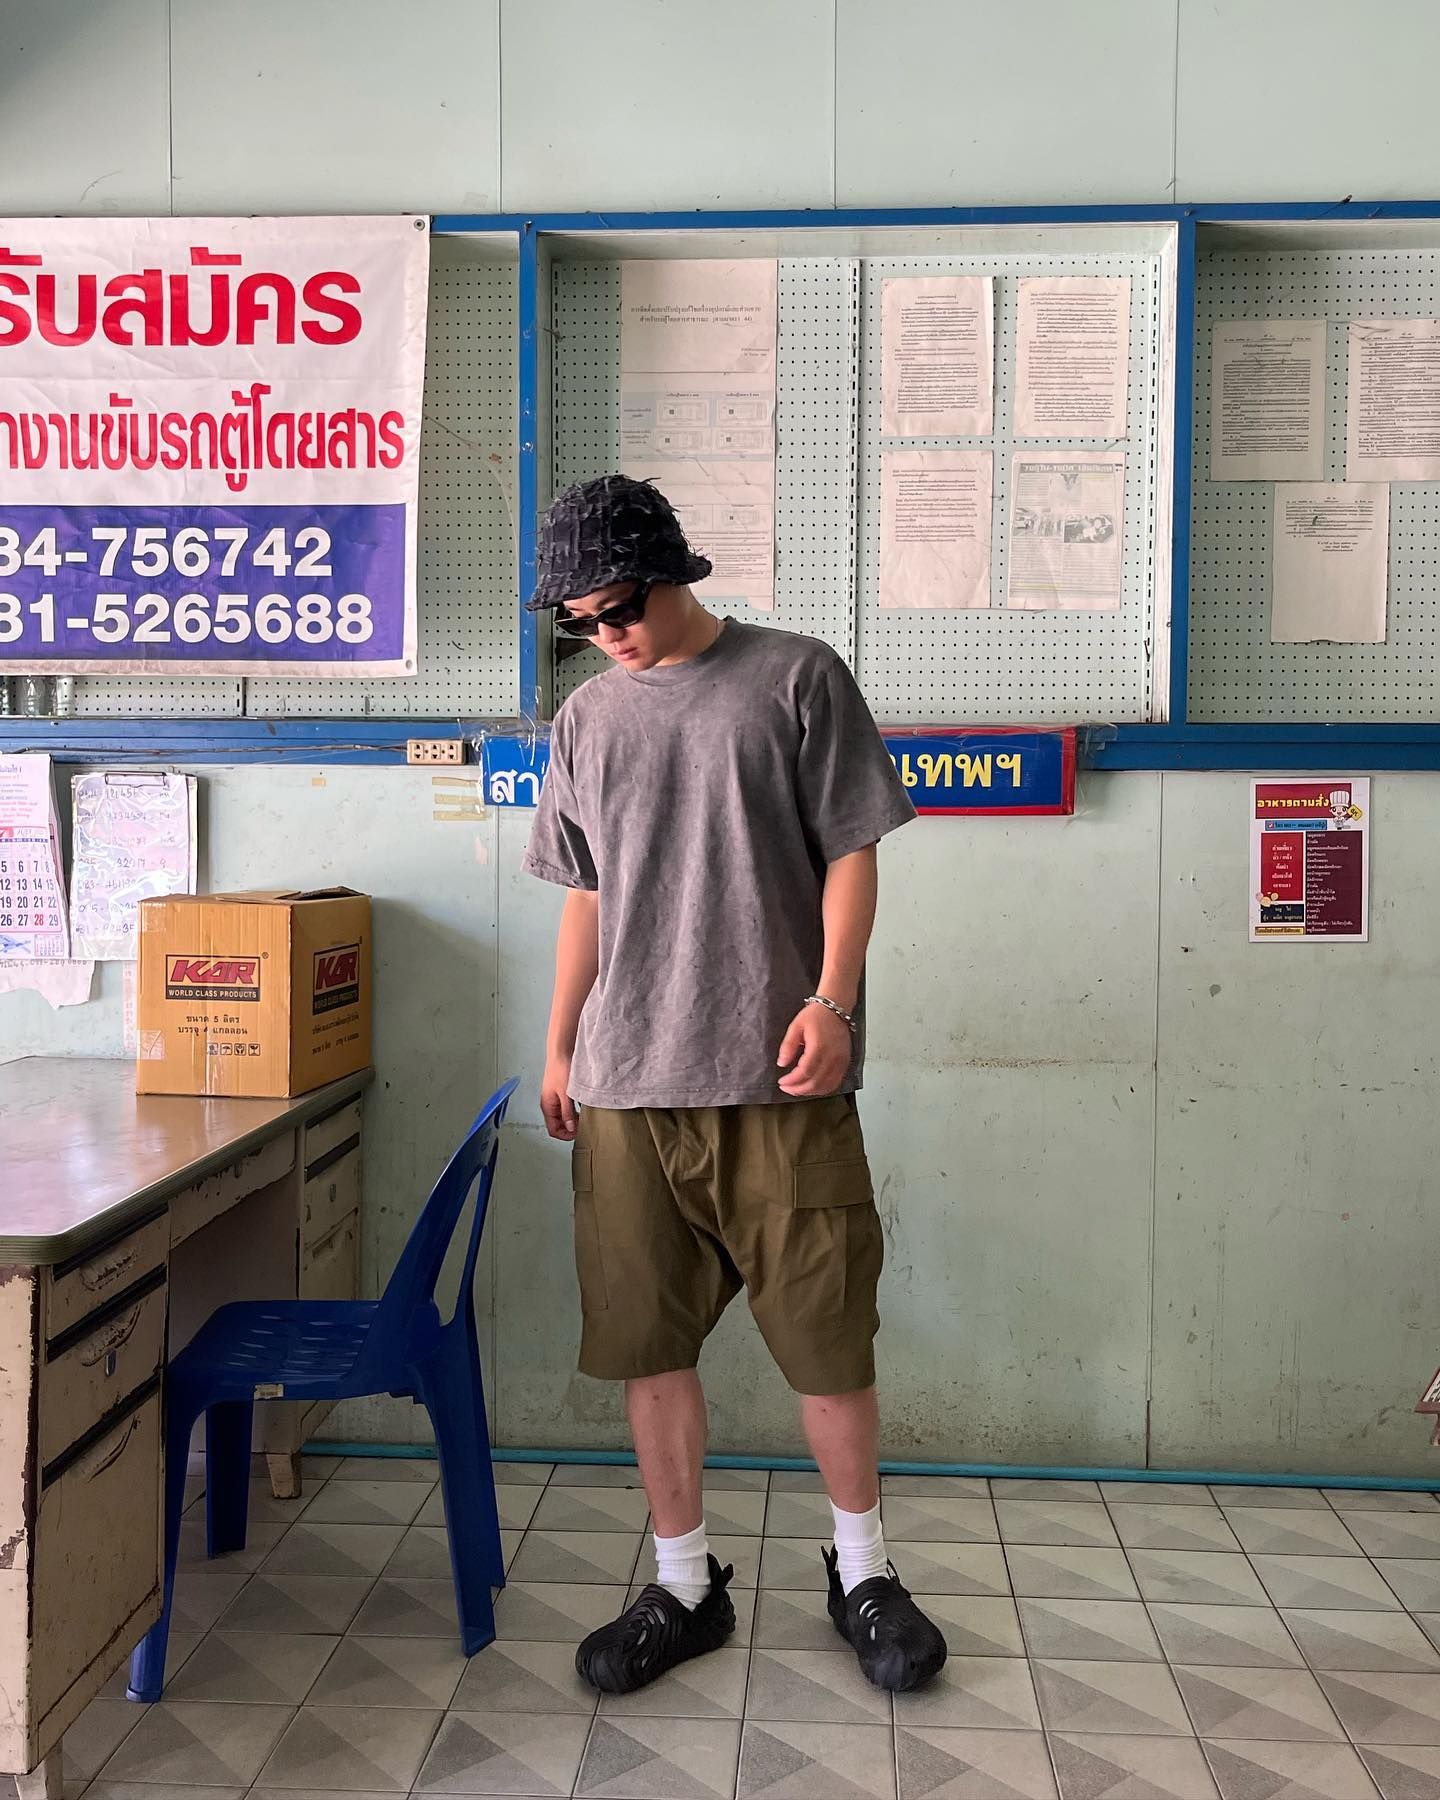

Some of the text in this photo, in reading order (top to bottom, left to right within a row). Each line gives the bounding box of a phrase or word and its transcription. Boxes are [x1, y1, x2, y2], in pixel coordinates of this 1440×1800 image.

[0, 593, 374, 644] 81-5265688
[891, 754, 1022, 787] เทพฯ
[490, 769, 540, 804] สา
[1257, 794, 1329, 808] อาหารตามสั่ง
[1, 860, 7, 873] 5
[18, 860, 24, 873] 6
[33, 860, 39, 873] 7
[0, 878, 11, 891] 12
[17, 878, 28, 891] 13
[33, 878, 43, 890] 14
[1, 896, 57, 908] 19 20 21 22
[1, 914, 59, 926] 26 27 28 29
[170, 960, 256, 984] KAR
[316, 951, 358, 990] KAR
[169, 989, 194, 997] WORLD
[195, 990, 218, 998] CLASS
[186, 1015, 209, 1023] ขนาด
[223, 1014, 240, 1024] ลิตร
[178, 1026, 200, 1036] บรรจุ
[213, 1027, 248, 1035] แกลลอน
